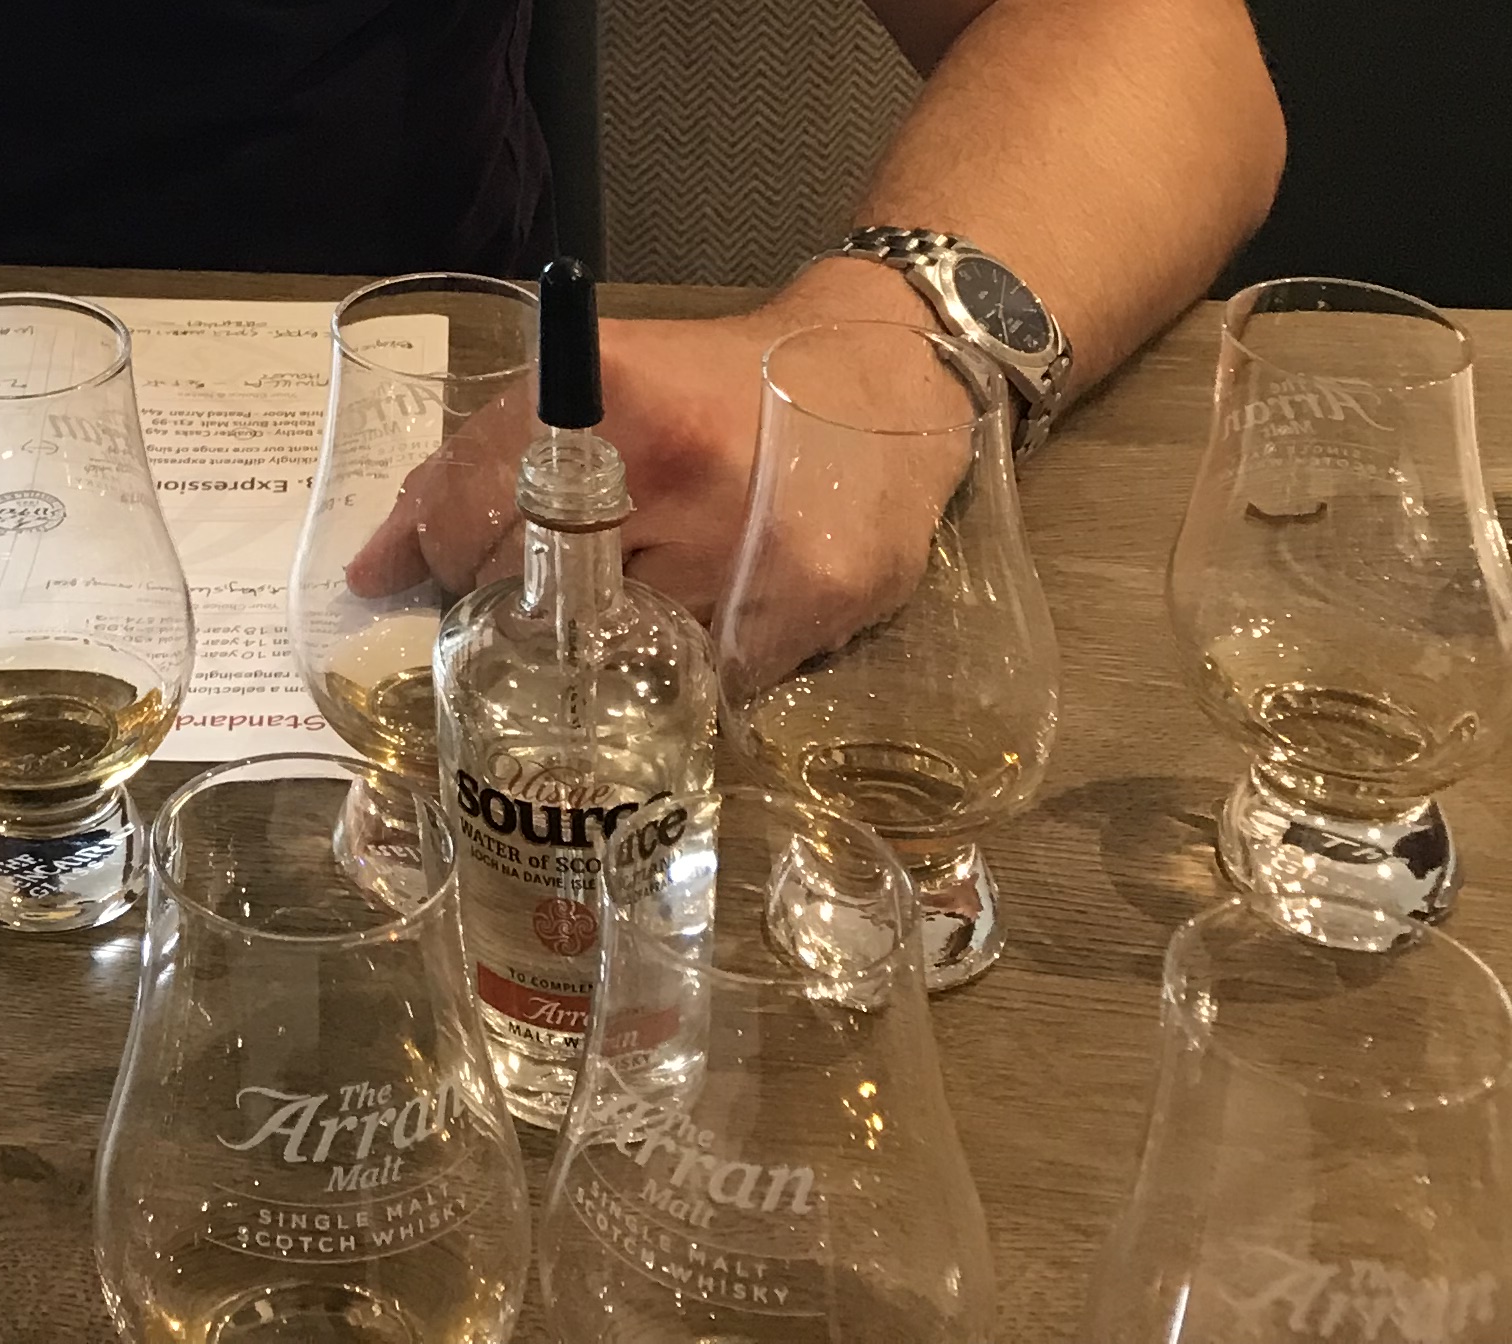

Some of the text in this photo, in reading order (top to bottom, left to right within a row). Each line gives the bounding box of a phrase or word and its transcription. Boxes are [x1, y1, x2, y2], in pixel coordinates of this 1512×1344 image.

[209, 458, 265, 466] different
[201, 648, 238, 658] year
[202, 637, 239, 646] year
[188, 686, 265, 696] selection
[175, 714, 326, 731] Standard
[460, 817, 522, 865] WATER
[528, 855, 550, 871] of
[570, 878, 597, 891] ISLE
[508, 967, 526, 983] TO
[339, 1079, 392, 1112] The
[216, 1079, 466, 1163] Arran
[590, 1064, 815, 1214] Arran
[327, 1157, 405, 1193] Malt
[258, 1182, 450, 1231] SINGLE MALT
[641, 1179, 715, 1230] Malt
[237, 1195, 466, 1254] SCOTCH WHISKY
[591, 1180, 769, 1279] SINGLE MALT
[574, 1185, 789, 1307] SCOTCH WHISKY
